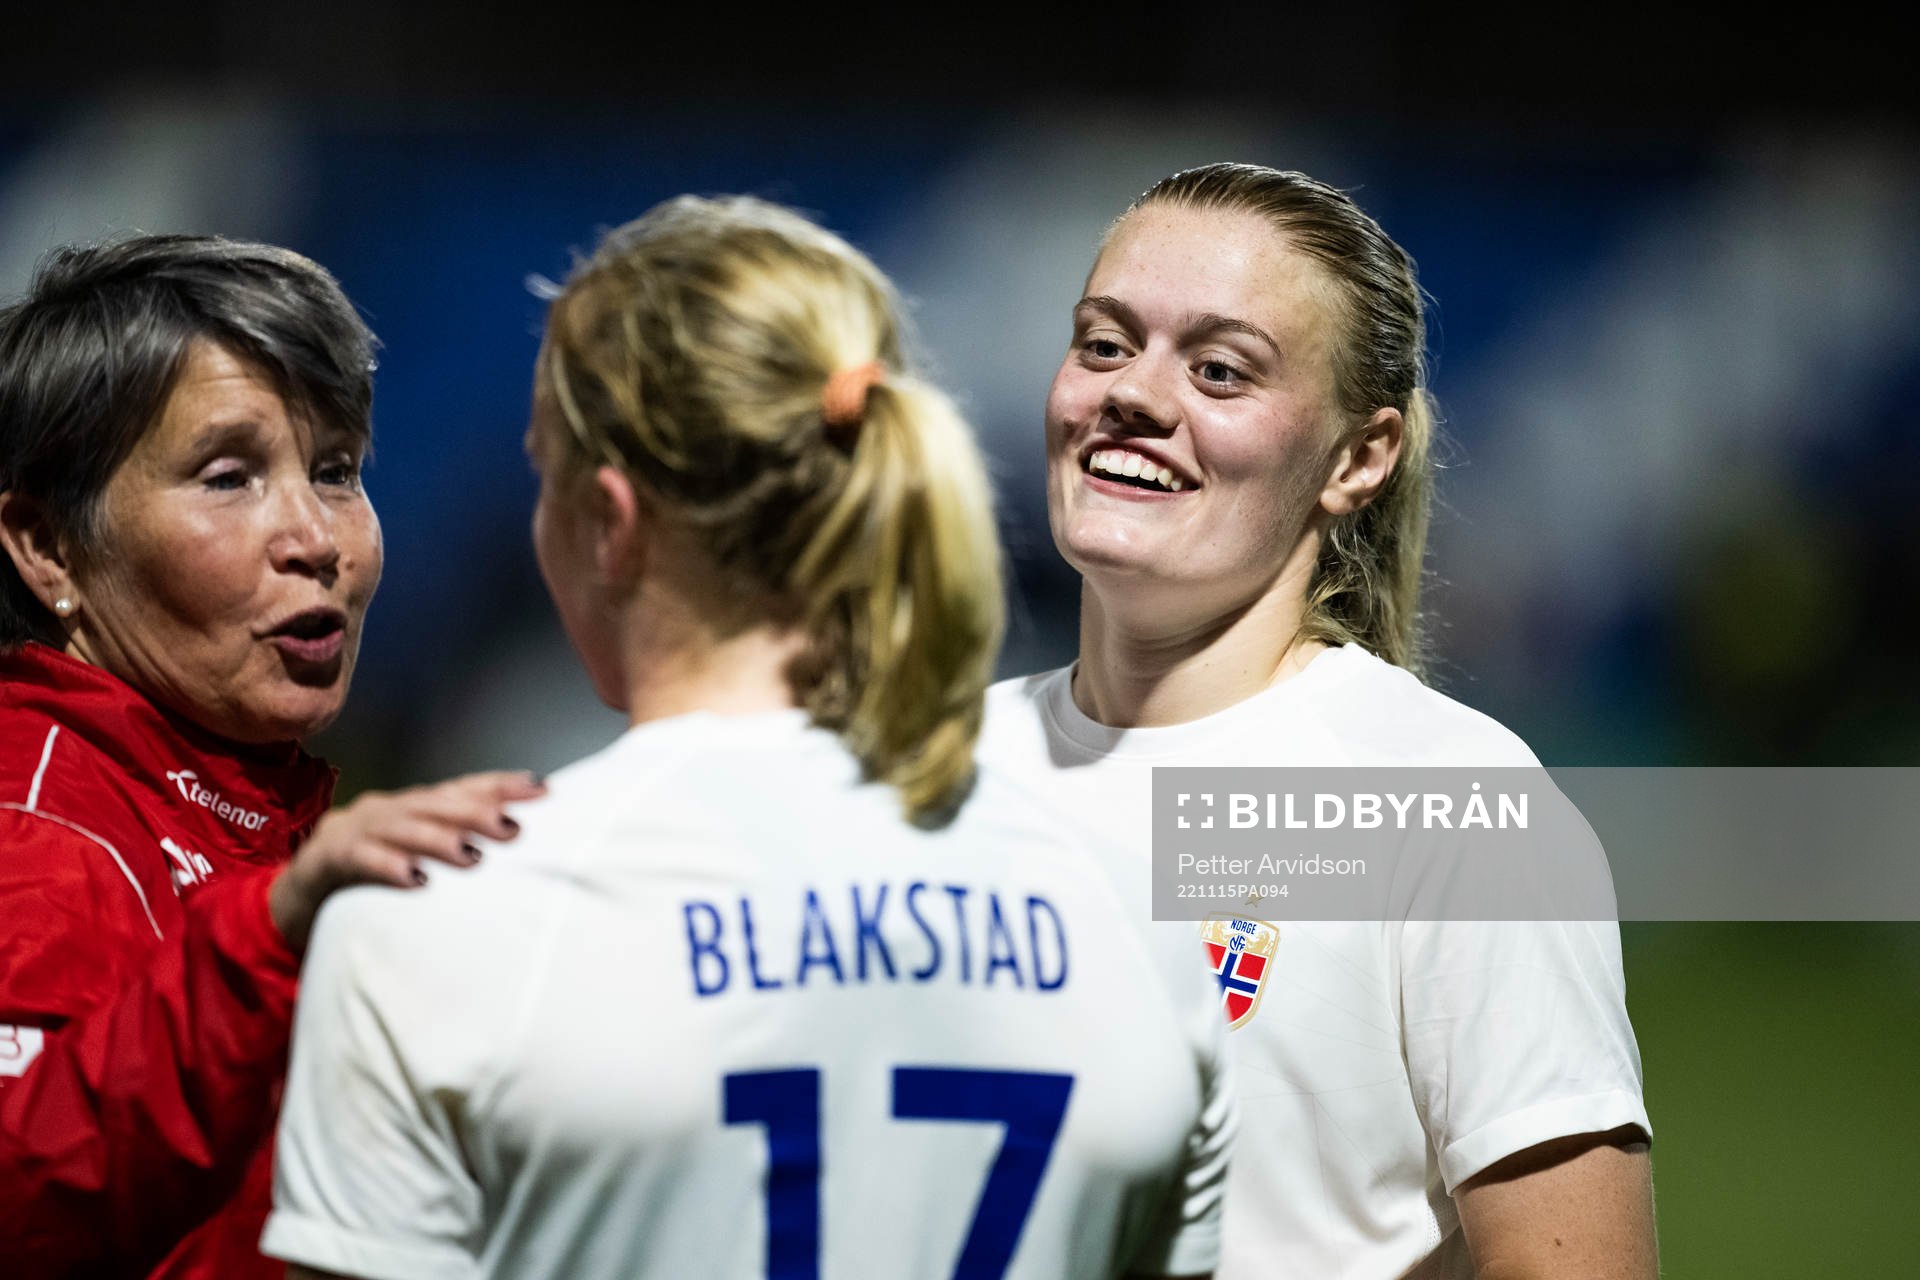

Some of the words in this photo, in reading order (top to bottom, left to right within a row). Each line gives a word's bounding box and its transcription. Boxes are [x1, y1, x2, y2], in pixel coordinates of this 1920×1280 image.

[190, 782, 269, 830] telenor
[682, 881, 1069, 997] BLAKSTAD
[1230, 919, 1257, 935] NORGE
[722, 1066, 1076, 1280] 17
